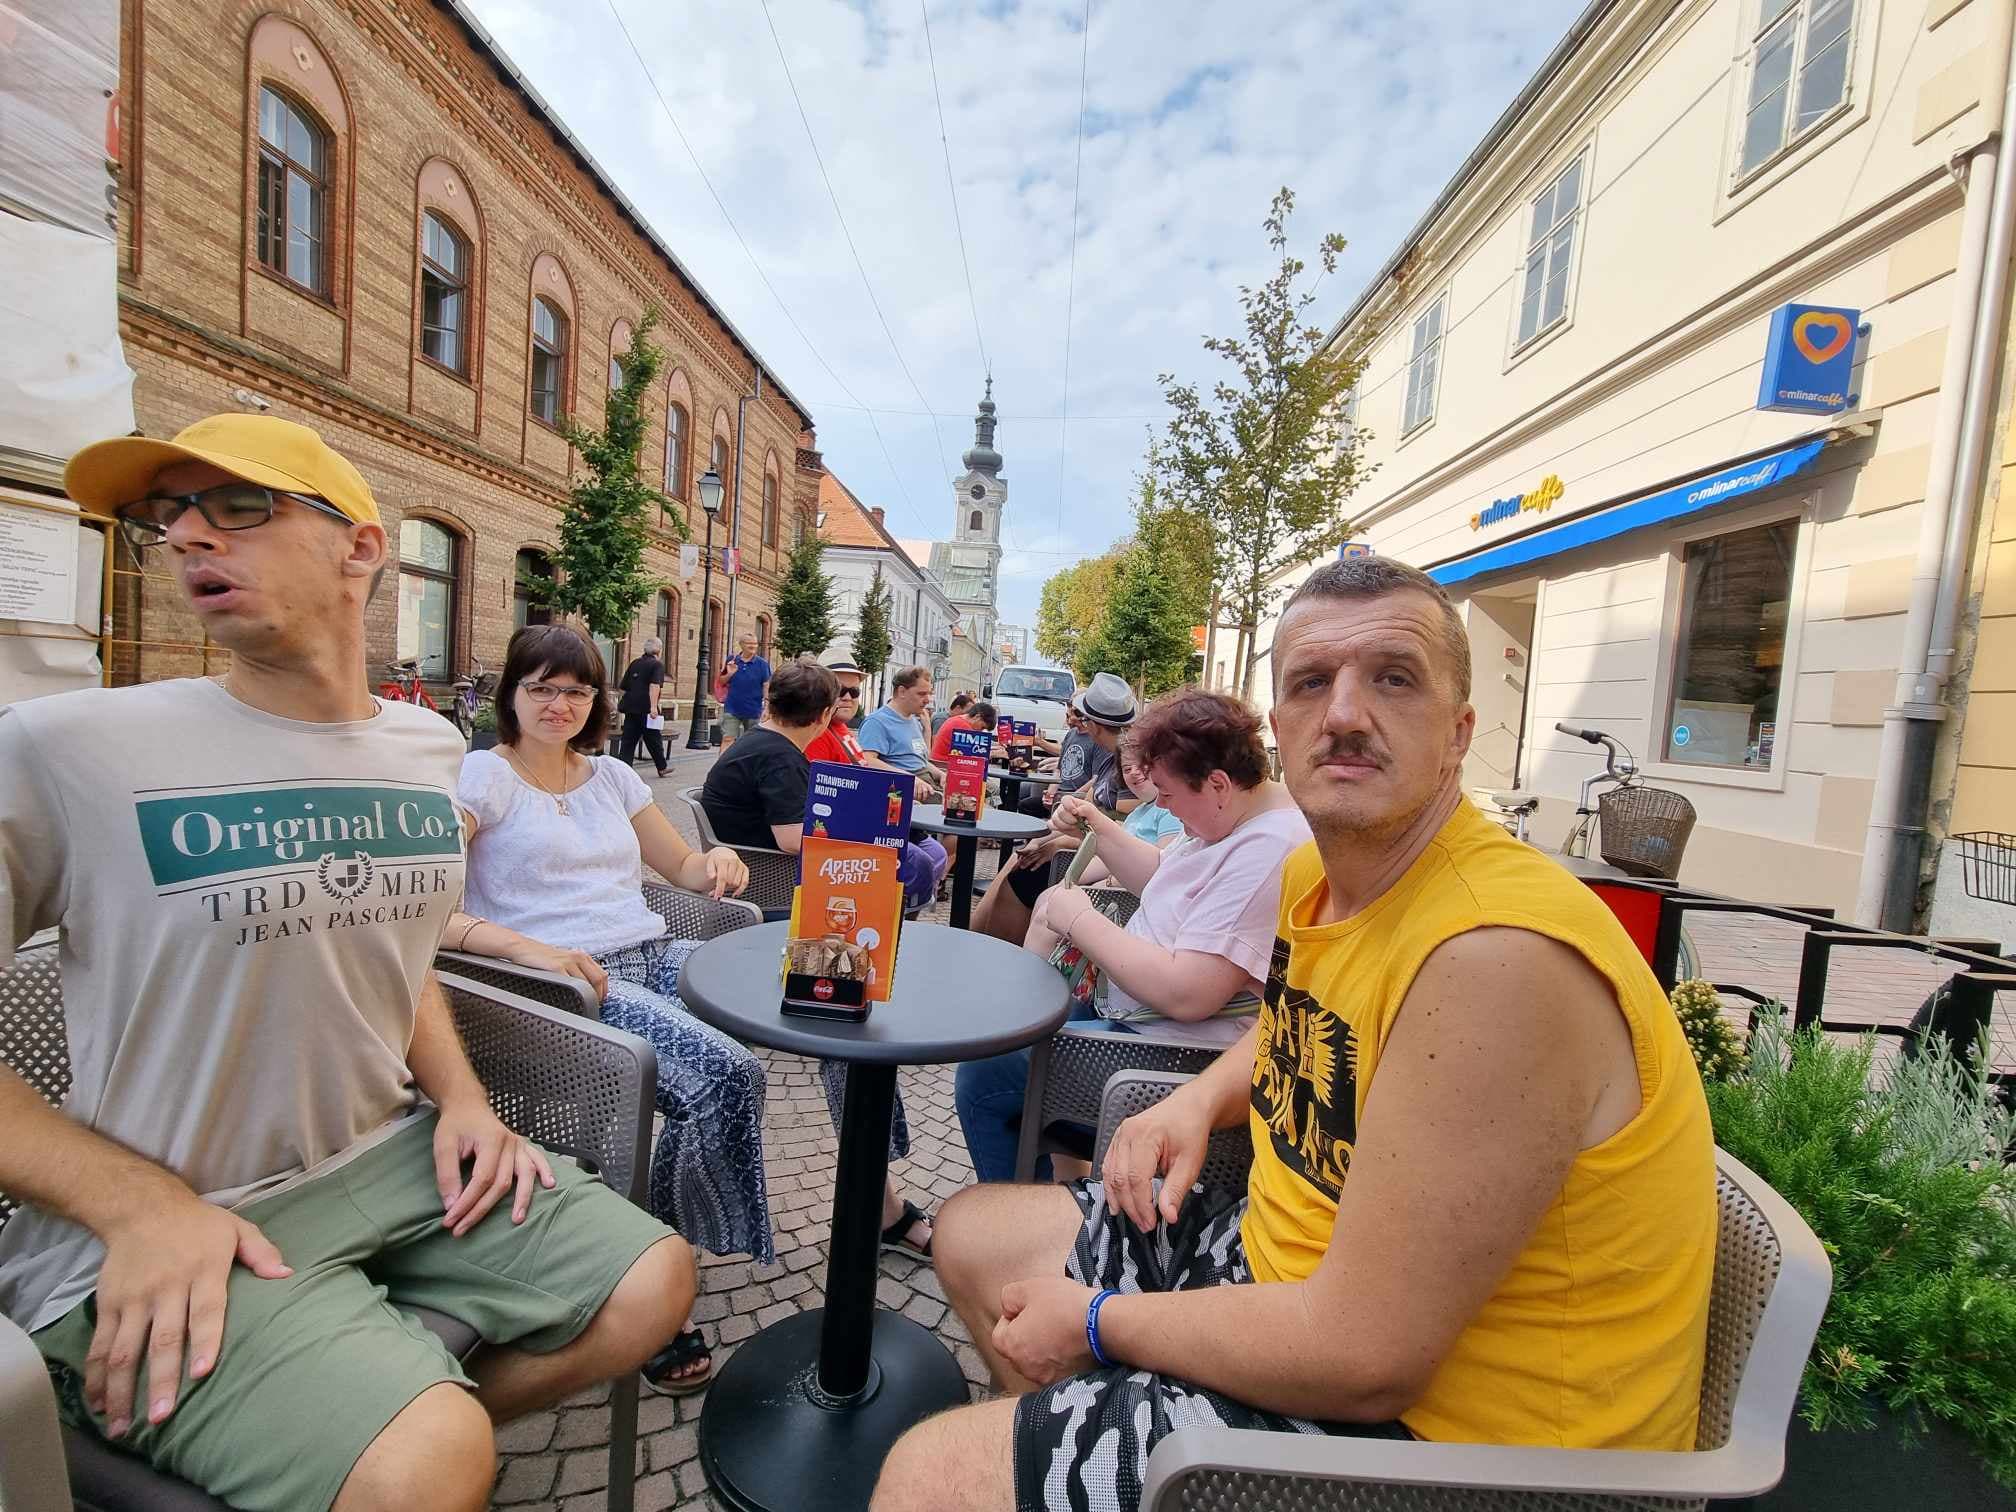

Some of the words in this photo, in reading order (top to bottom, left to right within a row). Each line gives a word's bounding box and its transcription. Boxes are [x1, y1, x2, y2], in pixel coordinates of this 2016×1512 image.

[1698, 462, 1779, 501] mlinarcaff
[953, 732, 989, 746] TIME
[814, 784, 838, 798] MOJITO
[815, 773, 860, 791] STRAWBERRY
[171, 801, 386, 860] Original
[398, 801, 453, 839] Co.
[873, 836, 905, 848] ALLEGRO
[819, 858, 880, 877] APEROL
[201, 881, 306, 923] TRD
[381, 868, 447, 898] MRK
[236, 917, 313, 946] JEAN
[327, 902, 427, 929] PASCALE
